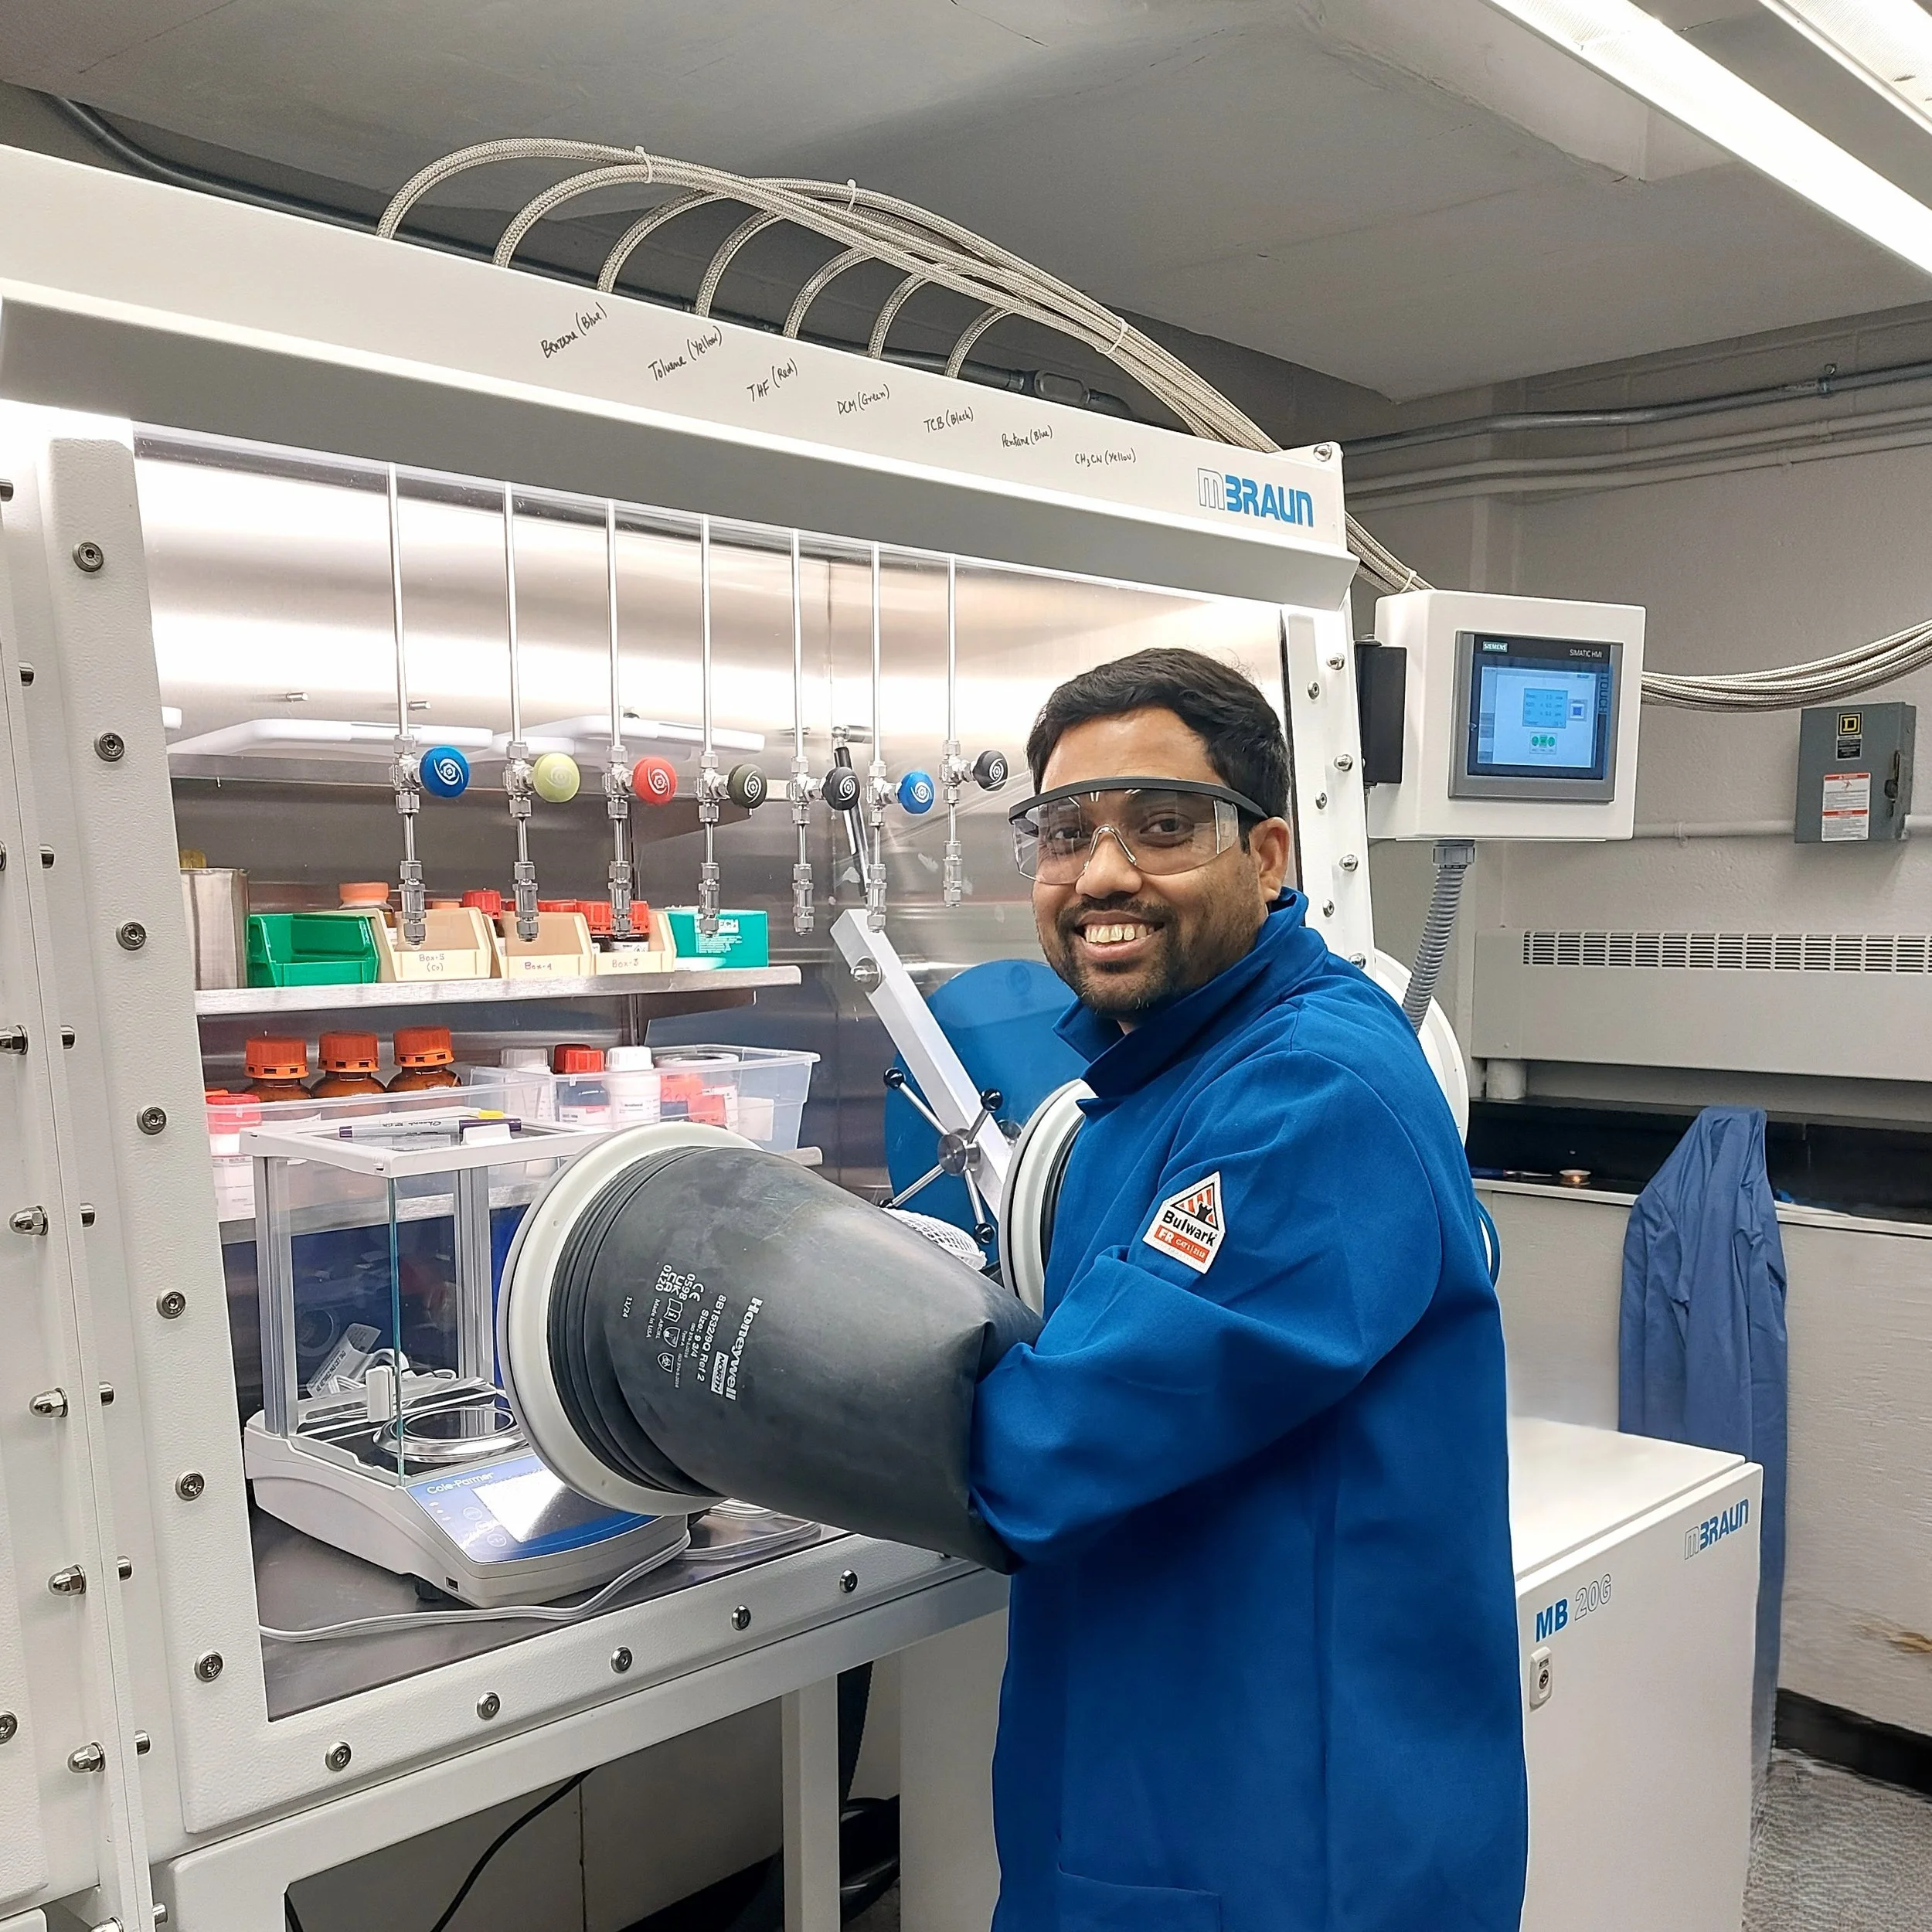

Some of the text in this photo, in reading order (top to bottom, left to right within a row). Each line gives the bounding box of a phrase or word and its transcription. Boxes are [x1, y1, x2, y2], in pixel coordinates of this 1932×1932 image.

[541, 301, 607, 359] Benzene (Blue)
[648, 325, 723, 381] Toluene (Yellow)
[747, 359, 798, 402] THF (Red)
[837, 384, 890, 415] DCM (Green)
[923, 417, 944, 433] TCB
[1483, 642, 1507, 651] SIEMENS
[1570, 649, 1591, 658] SIMATIC
[1597, 675, 1609, 715] TOUCH
[1158, 1227, 1175, 1244] FR
[1162, 1210, 1216, 1247] Bulwark
[655, 1264, 672, 1291] 0120
[679, 1273, 696, 1301] 0598
[702, 1294, 726, 1352] 8B1532/9Q
[725, 1297, 764, 1401] Honeywell
[714, 1355, 726, 1394] NORTH
[427, 1471, 495, 1494] Cole-Parmer
[1535, 1573, 1611, 1643] MB 20G
